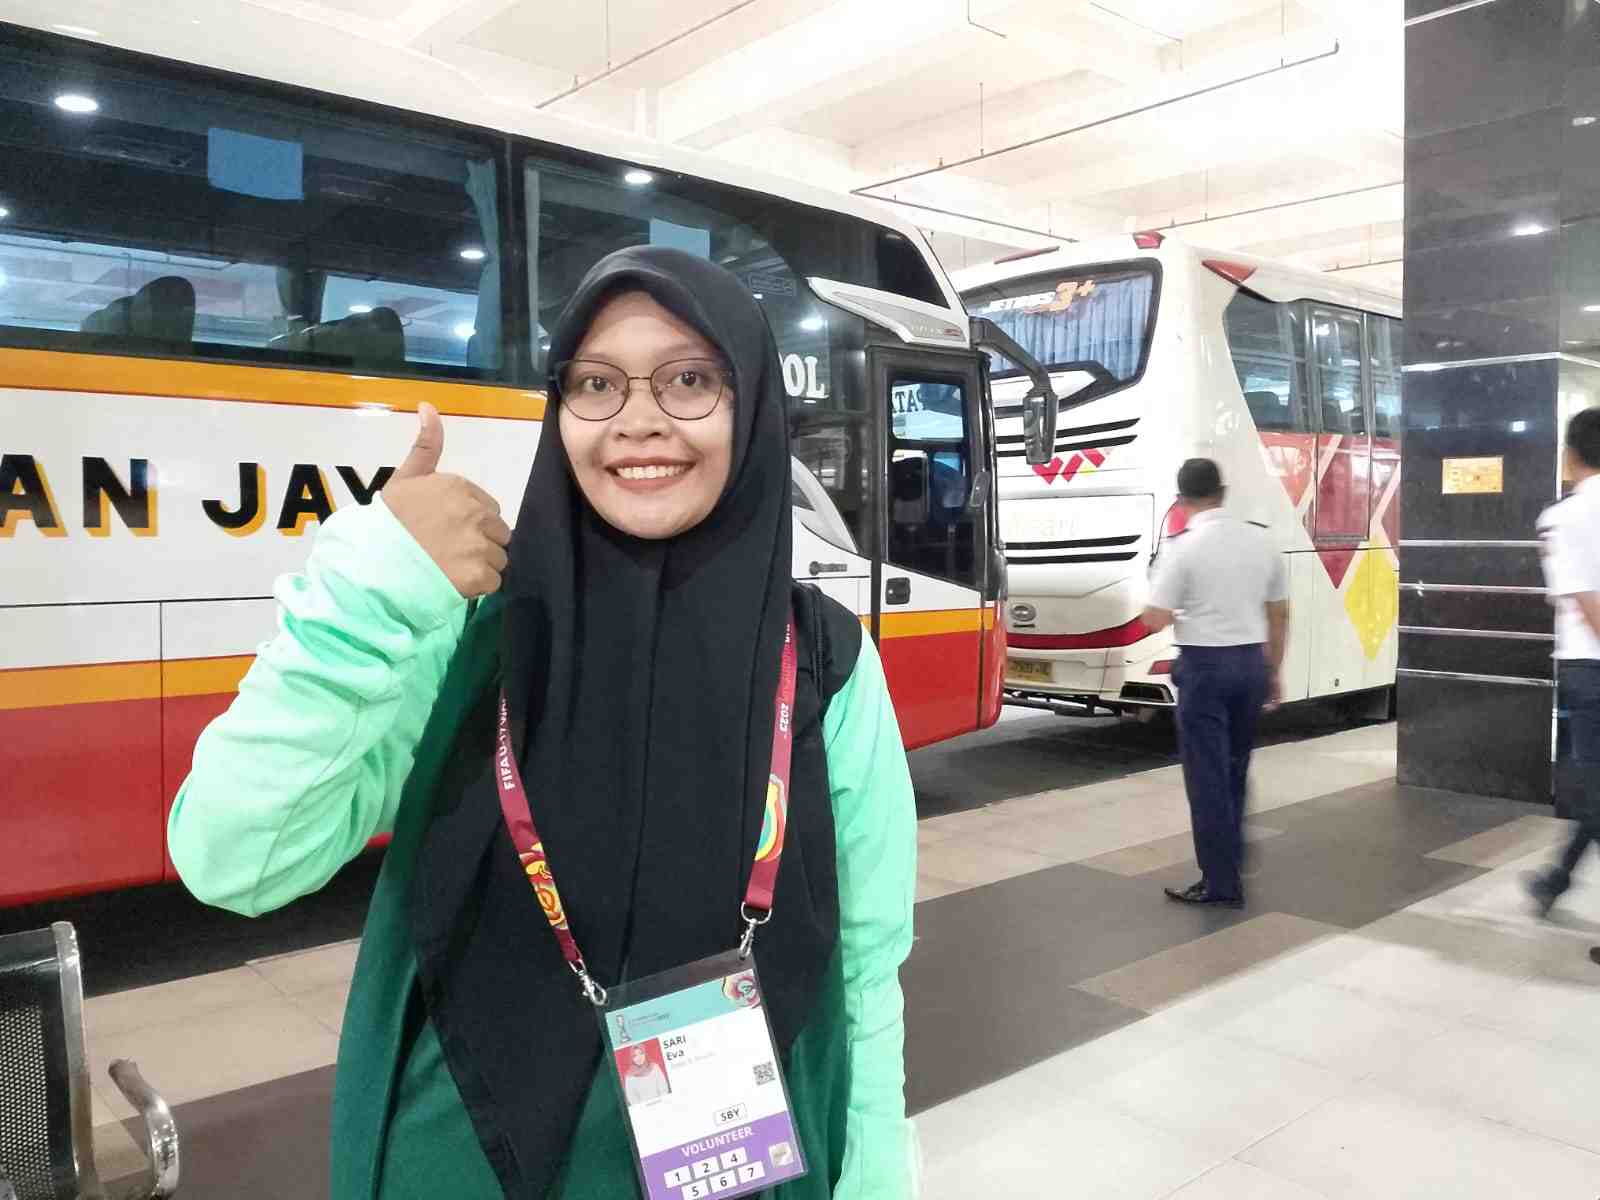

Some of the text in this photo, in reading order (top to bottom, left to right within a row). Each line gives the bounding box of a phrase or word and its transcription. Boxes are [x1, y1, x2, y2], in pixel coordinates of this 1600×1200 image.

[778, 352, 829, 398] OL
[0, 454, 158, 537] AN
[500, 757, 516, 791] FIFA
[663, 1035, 687, 1049] SARI
[666, 1049, 685, 1061] Eva
[720, 1108, 740, 1121] SBY
[681, 1126, 753, 1158] VOLUNTEER
[675, 1153, 738, 1182] 1 2 4
[692, 1167, 755, 1197] 5 6 7
